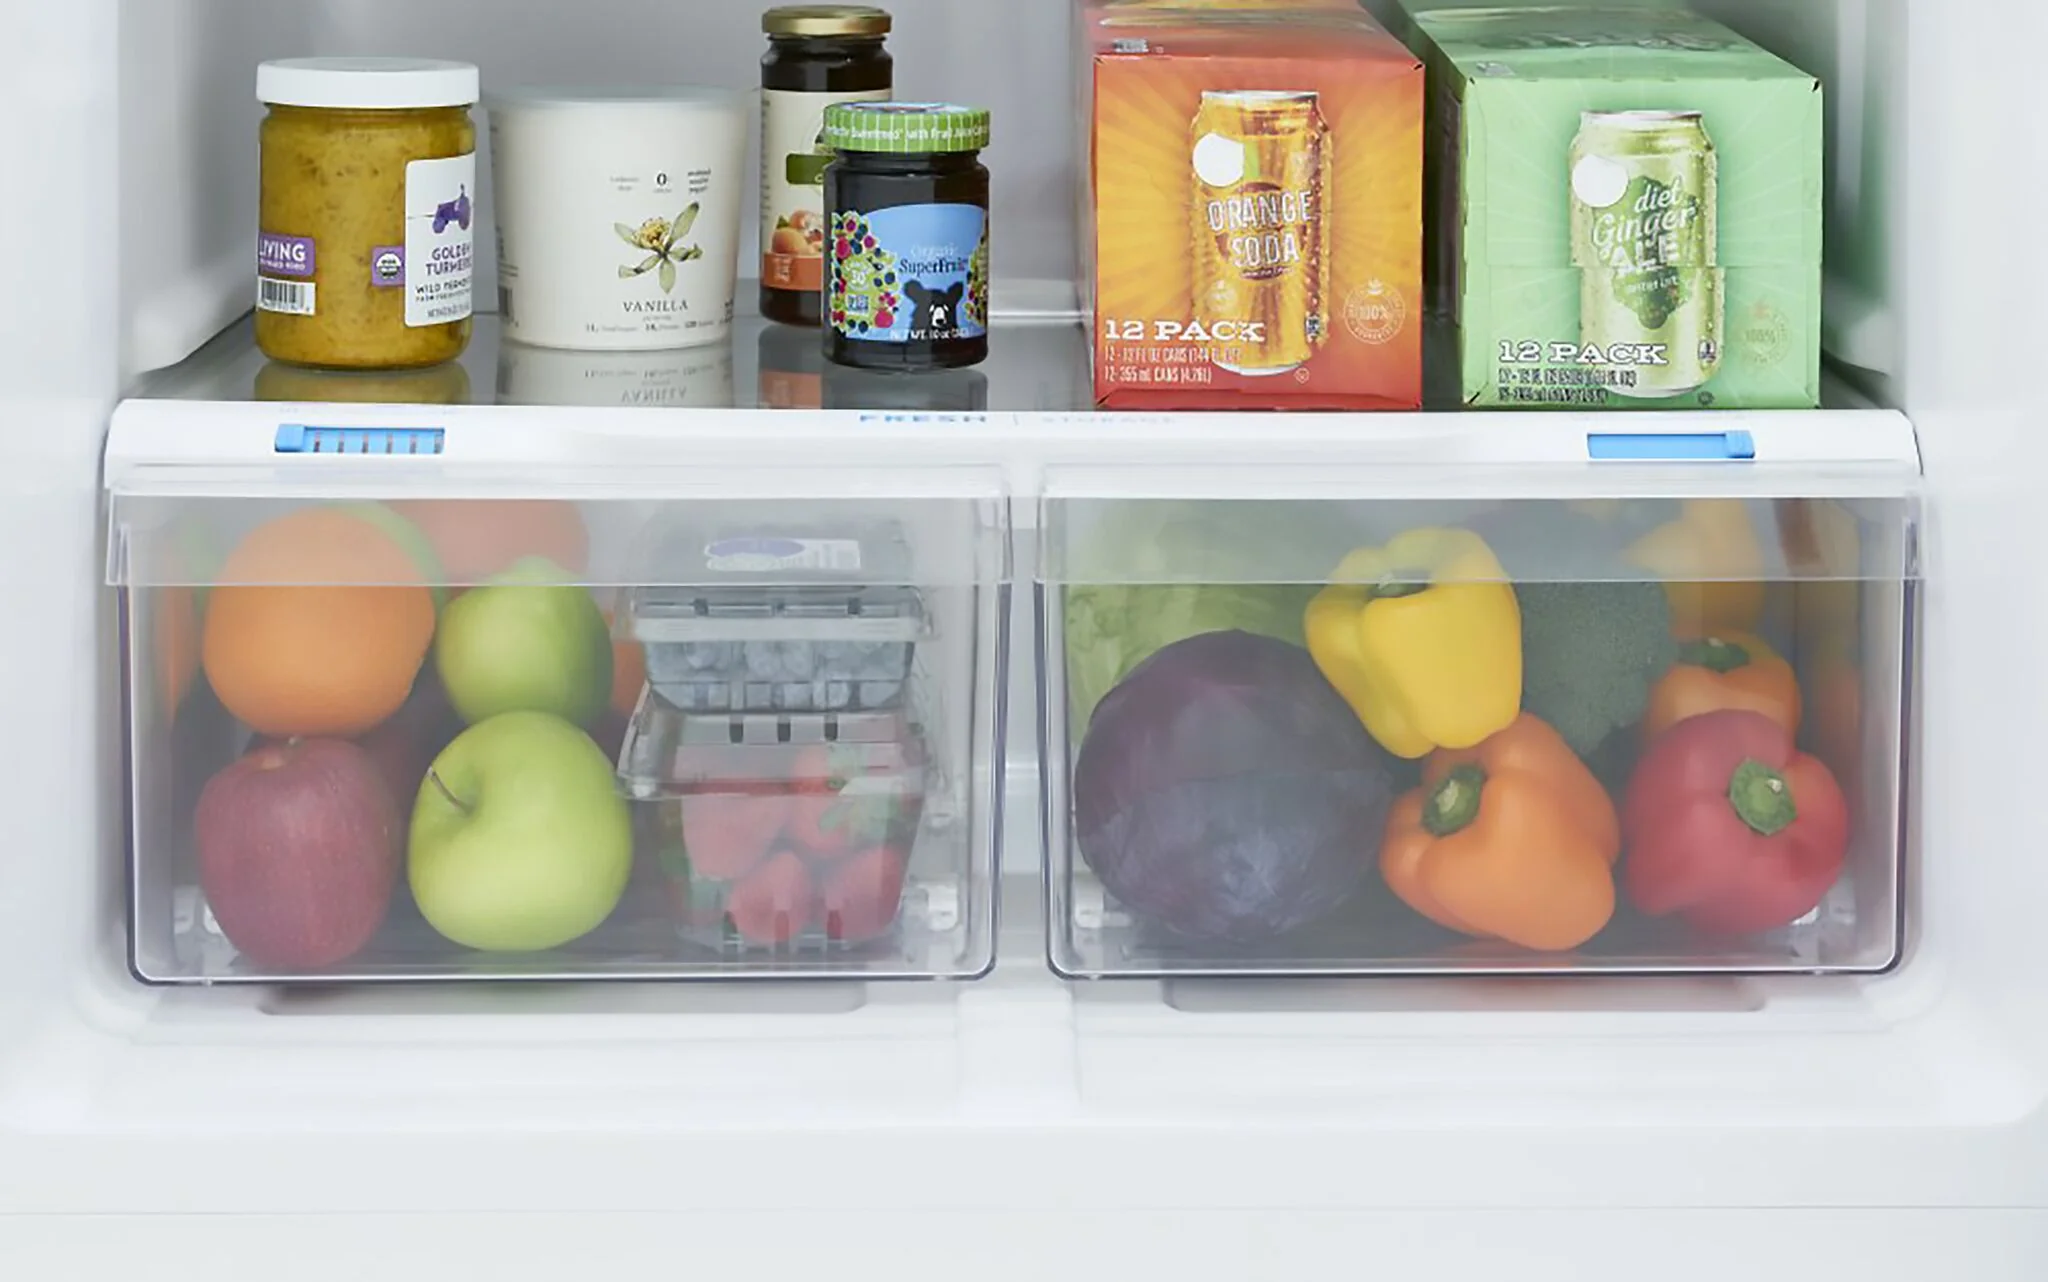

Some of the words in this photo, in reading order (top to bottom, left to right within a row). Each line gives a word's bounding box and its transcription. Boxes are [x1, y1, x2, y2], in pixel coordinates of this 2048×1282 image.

[1208, 190, 1313, 231] ORANGE
[1634, 173, 1683, 213] diet
[1231, 232, 1300, 267] SODA
[1592, 204, 1698, 262] Ginger
[1609, 231, 1681, 278] ALE
[623, 300, 688, 312] VANILLA
[1105, 319, 1144, 340] 12
[1154, 319, 1265, 342] PACK
[1500, 341, 1540, 363] 12
[1549, 342, 1669, 364] PACK
